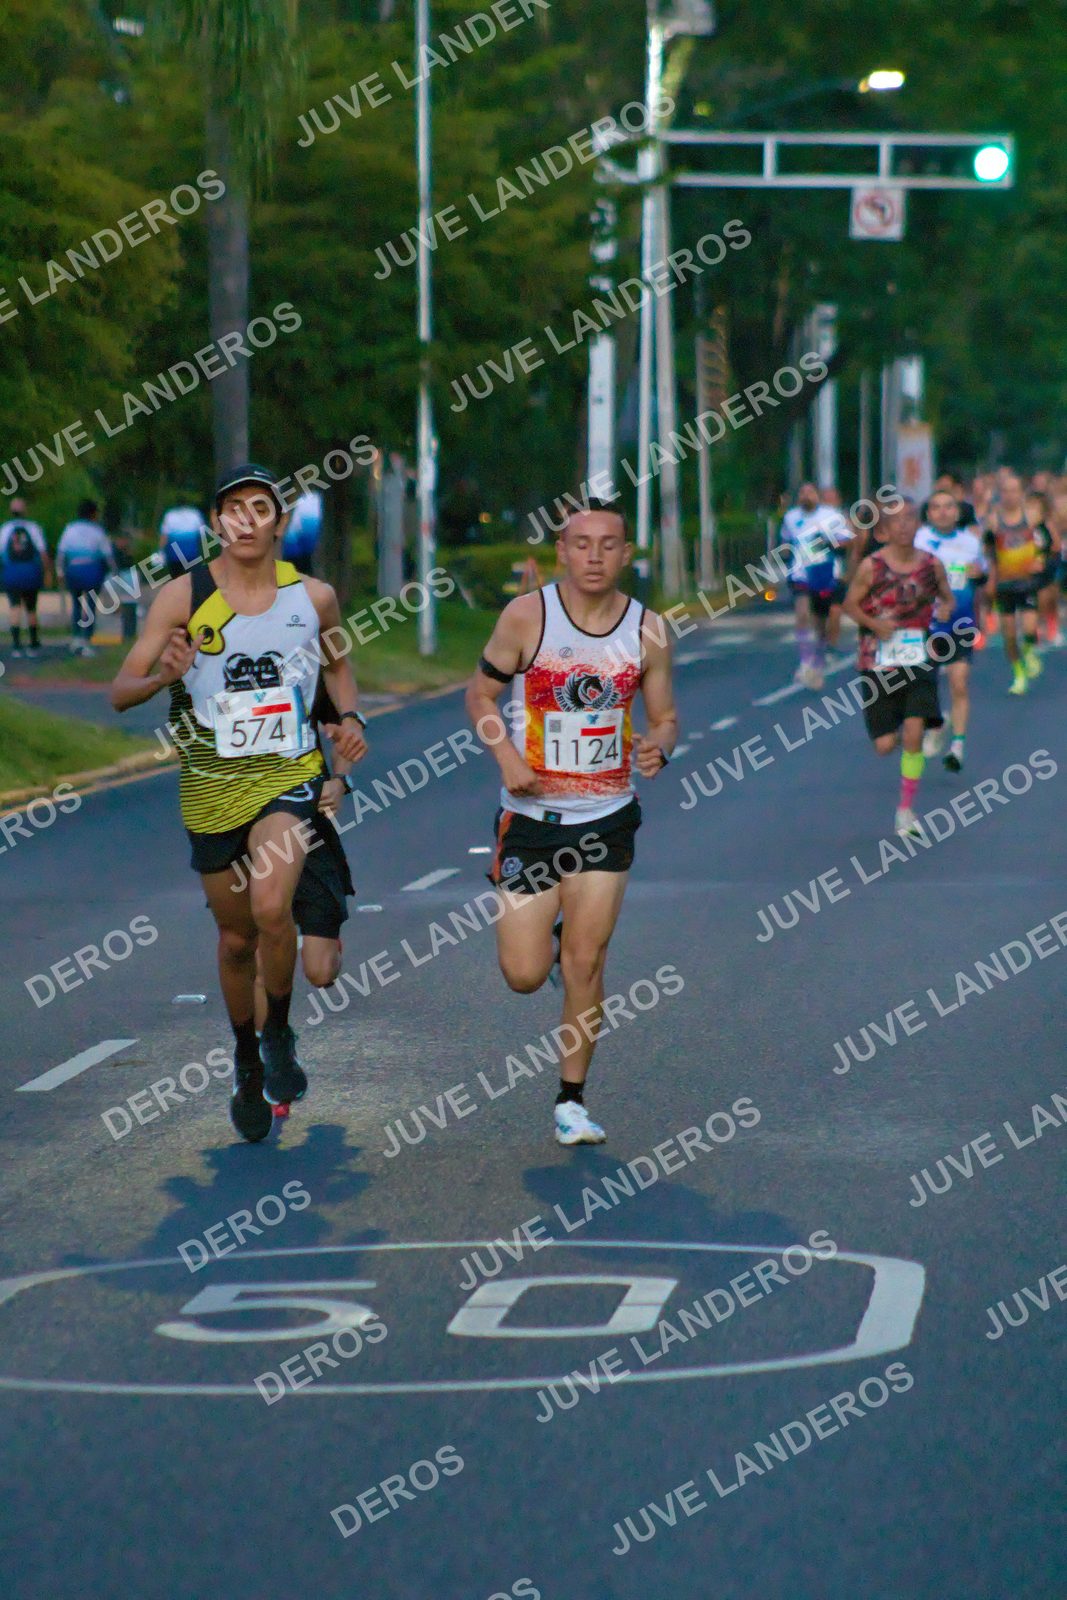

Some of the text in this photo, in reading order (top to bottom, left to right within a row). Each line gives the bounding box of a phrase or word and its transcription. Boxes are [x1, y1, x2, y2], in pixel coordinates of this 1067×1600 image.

[230, 716, 286, 748] 574
[552, 736, 618, 766] 1124
[153, 1275, 678, 1342] 50
